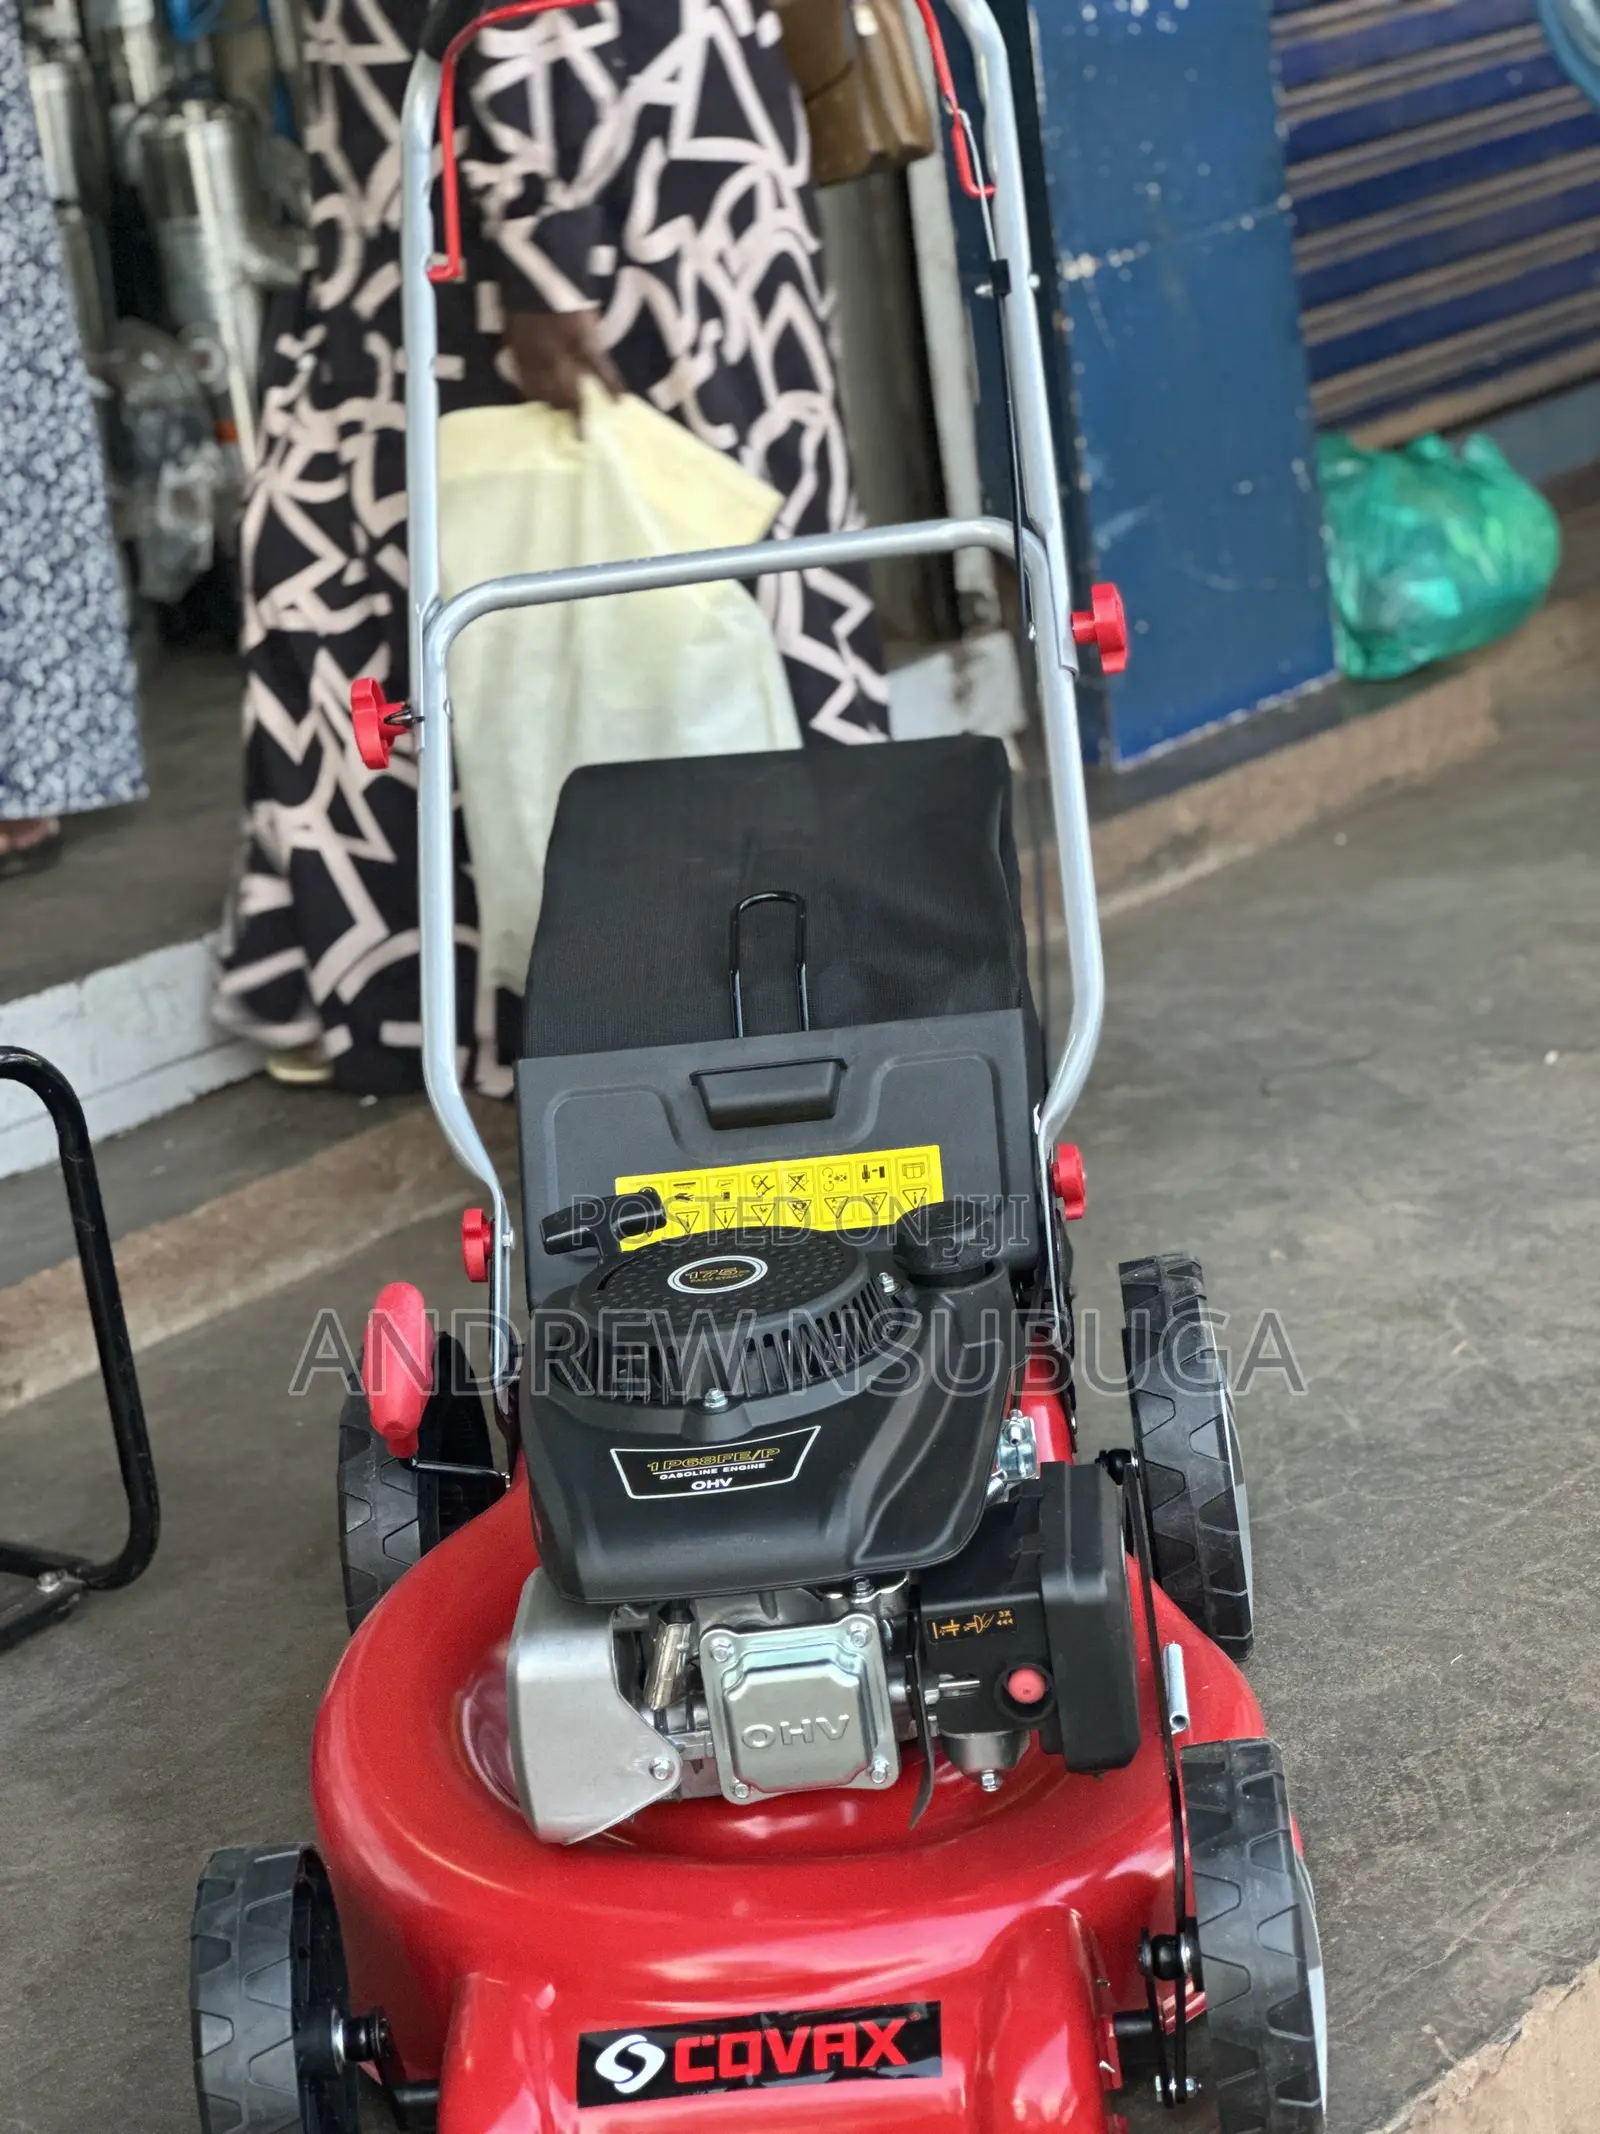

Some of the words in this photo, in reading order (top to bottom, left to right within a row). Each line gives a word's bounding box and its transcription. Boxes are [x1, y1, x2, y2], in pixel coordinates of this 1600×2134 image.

[659, 1468, 718, 1480] GASOLINE
[722, 1463, 766, 1473] ENGINE
[691, 1477, 733, 1491] OHV
[741, 1714, 849, 1749] OHV
[674, 2019, 908, 2083] COVAX
